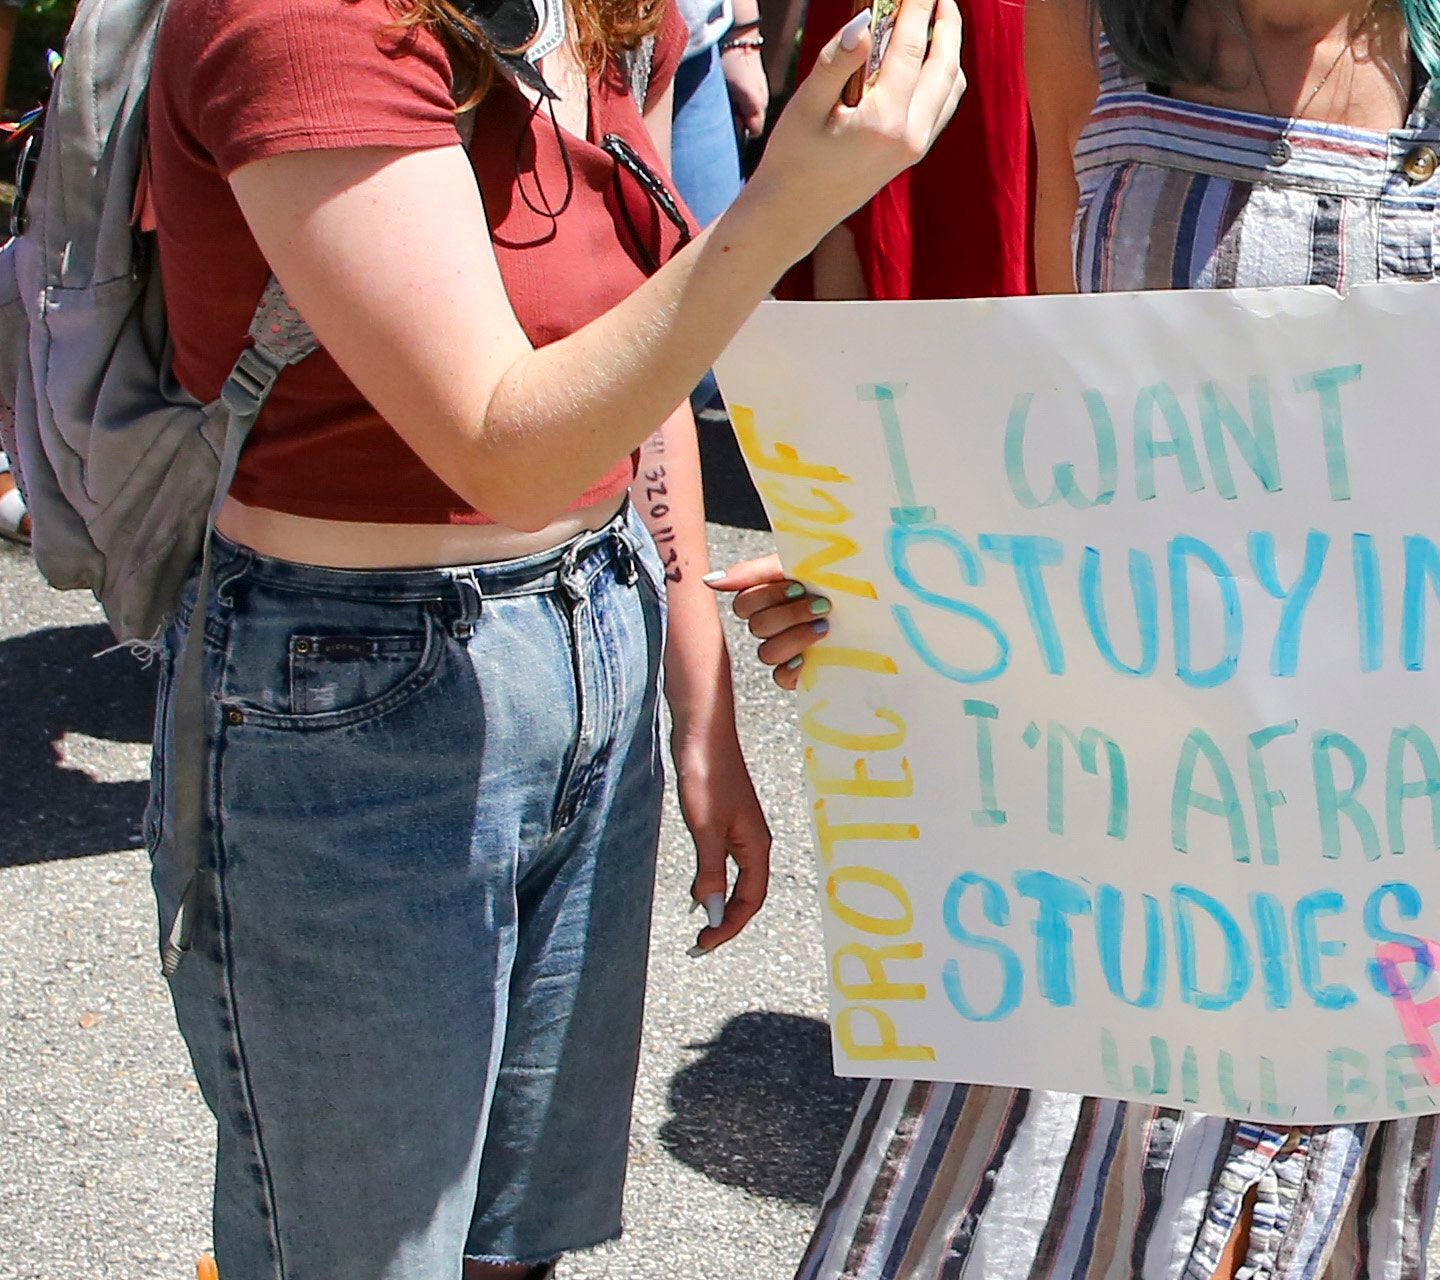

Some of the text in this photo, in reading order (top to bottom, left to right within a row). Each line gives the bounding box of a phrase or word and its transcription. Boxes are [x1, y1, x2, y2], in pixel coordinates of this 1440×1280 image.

[728, 402, 882, 605] NCF
[856, 380, 937, 522] I
[1003, 363, 1363, 510] WANT
[965, 697, 1129, 842] I'M
[800, 639, 939, 1064] PROTECT
[941, 867, 1434, 1024] STUDIES
[1100, 1026, 1437, 1120] WILL BE
